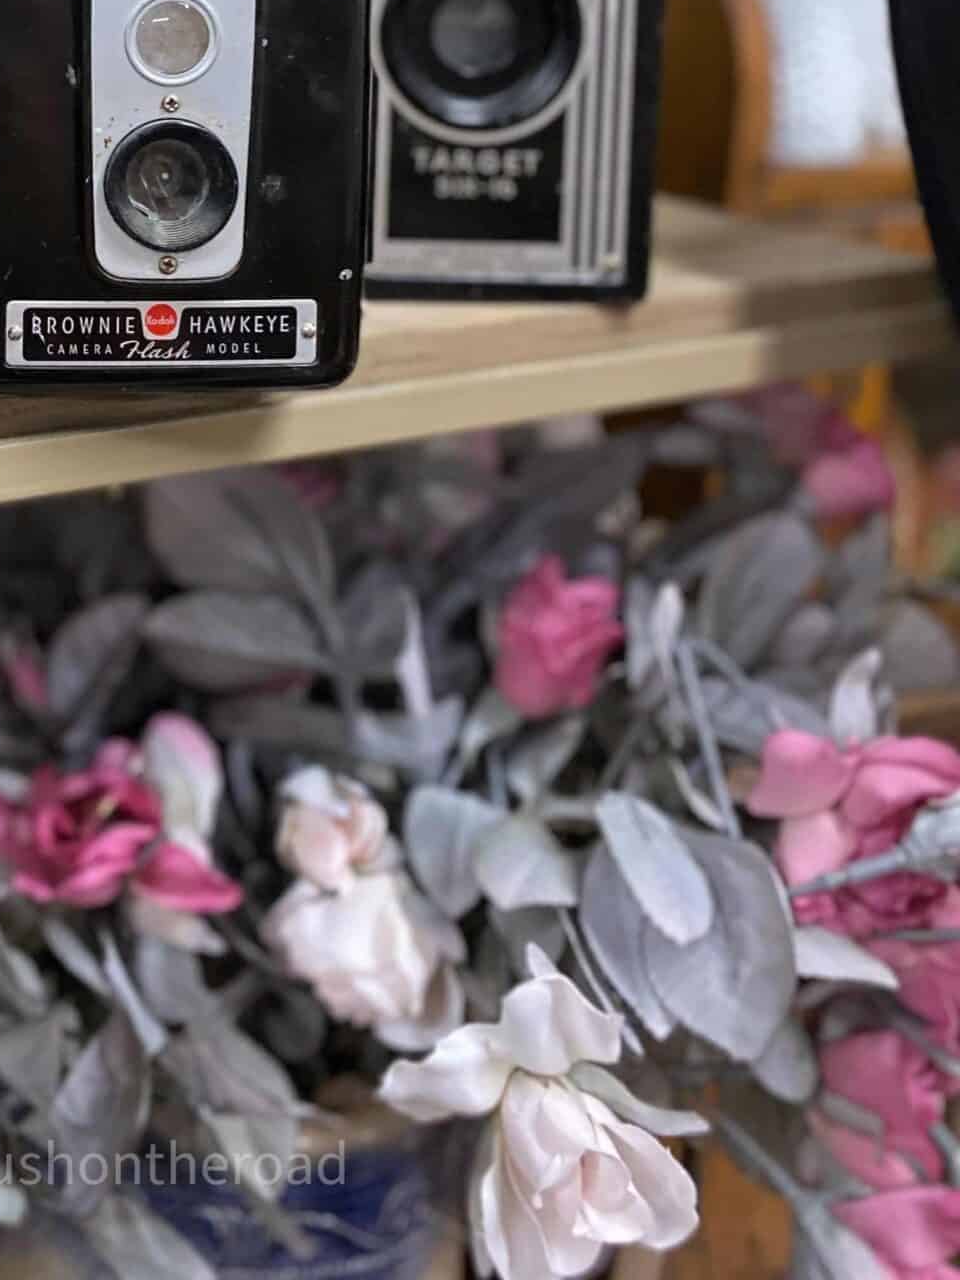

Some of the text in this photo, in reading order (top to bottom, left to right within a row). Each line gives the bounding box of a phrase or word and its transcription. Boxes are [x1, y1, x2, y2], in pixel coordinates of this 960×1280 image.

[412, 145, 543, 177] TARGET
[32, 314, 137, 335] BROWNIE
[189, 314, 290, 334] HAWKEYE
[46, 339, 262, 359] CAMERA Flash MODEL
